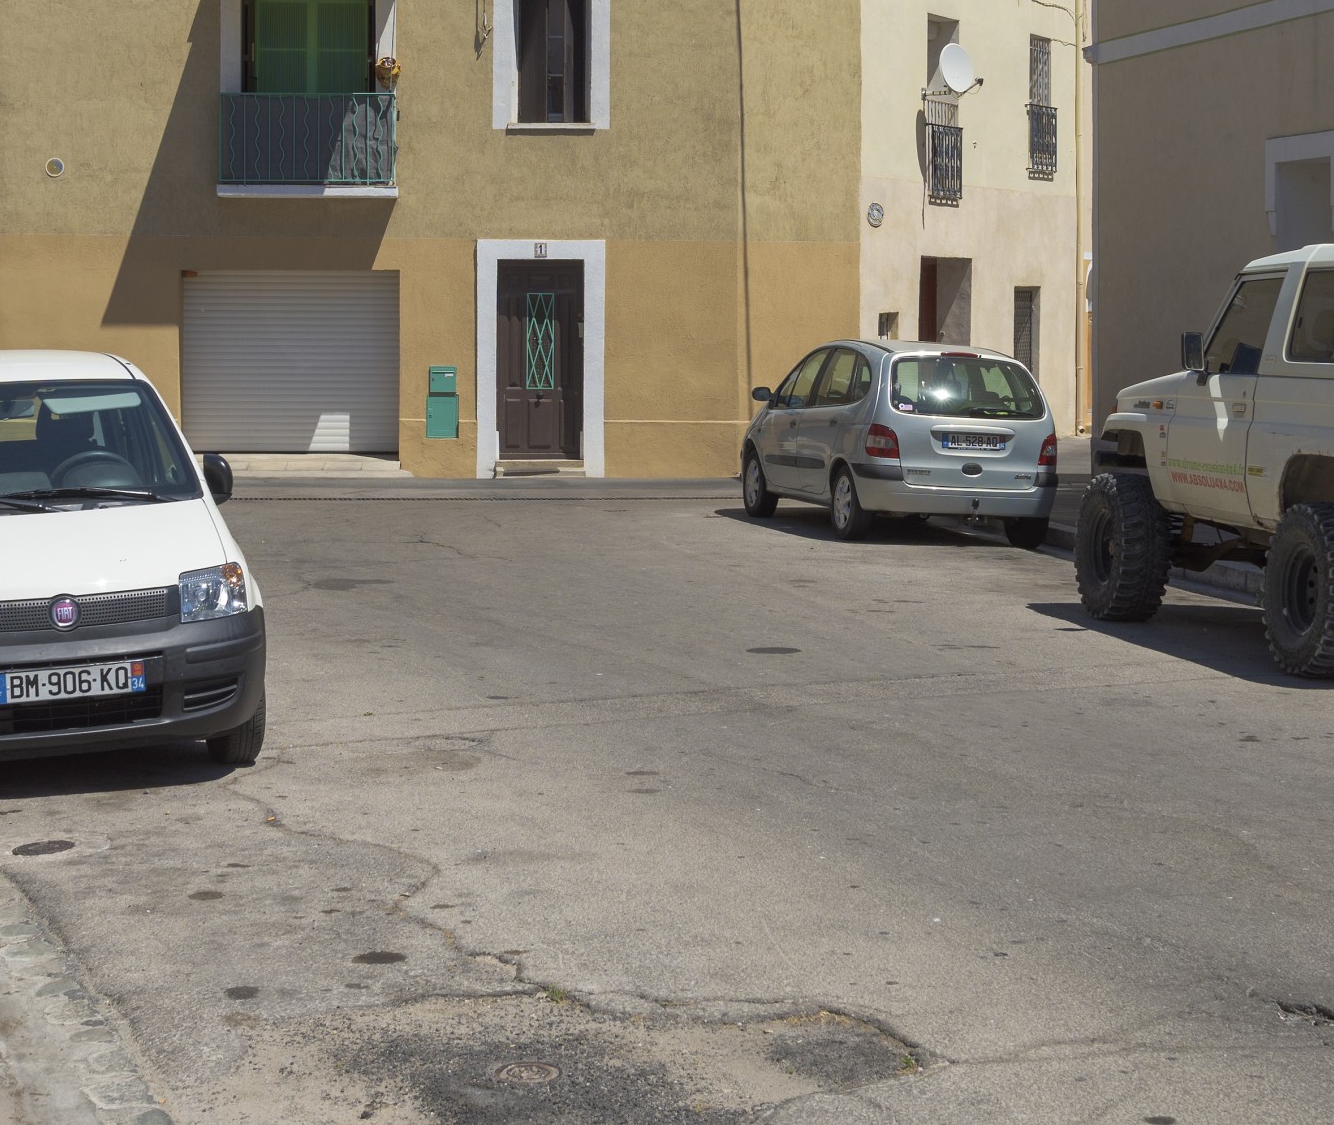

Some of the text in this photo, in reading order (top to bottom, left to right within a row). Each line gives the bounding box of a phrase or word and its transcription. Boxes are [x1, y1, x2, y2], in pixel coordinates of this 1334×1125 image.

[57, 606, 73, 620] FIAT
[10, 666, 129, 700] BM-906-KQ
[131, 677, 145, 689] 34
